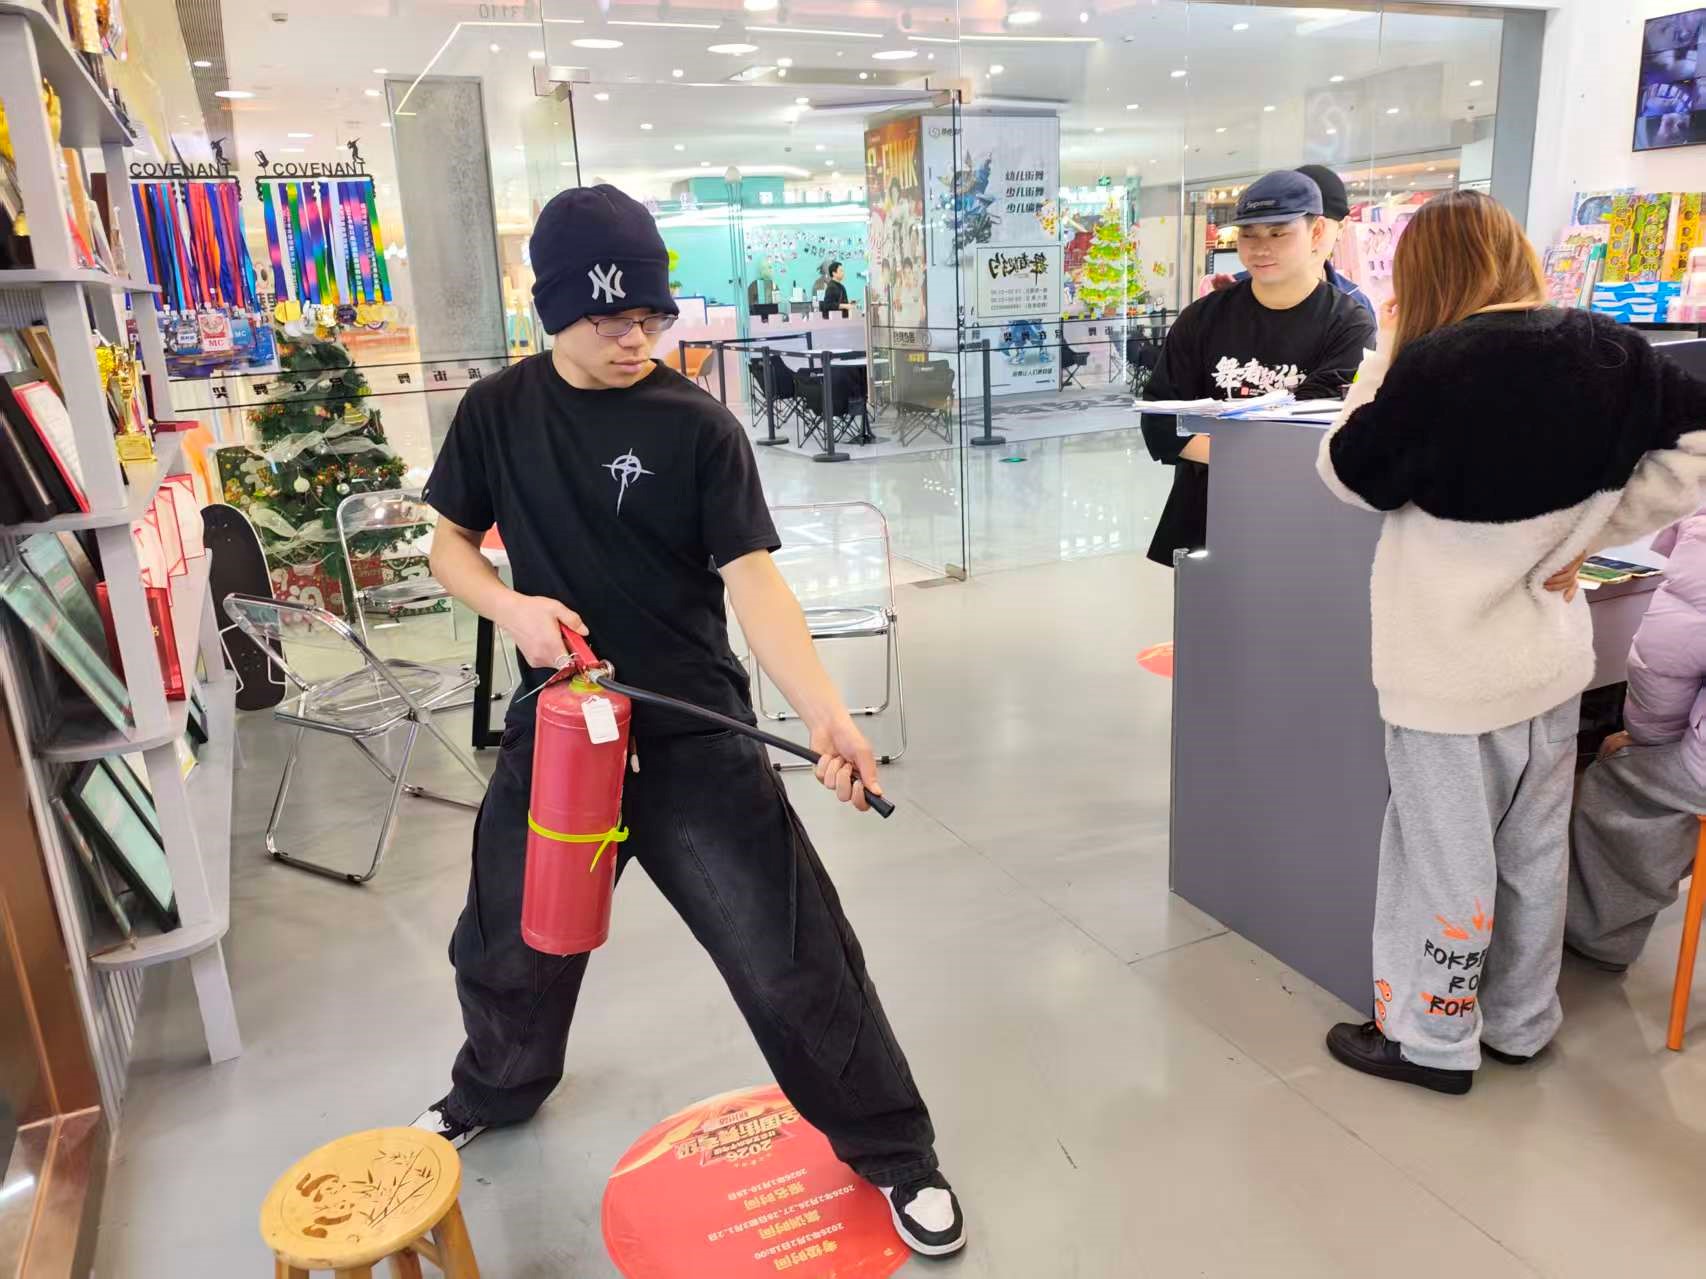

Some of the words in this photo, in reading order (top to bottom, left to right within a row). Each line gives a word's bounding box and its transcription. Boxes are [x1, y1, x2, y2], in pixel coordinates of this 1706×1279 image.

[130, 162, 232, 176] COVENANT
[273, 162, 366, 176] COVENANT
[587, 263, 626, 303] NY
[1424, 939, 1489, 970] ROKB
[1430, 995, 1476, 1018] ROK
[726, 1139, 772, 1162] 2026
